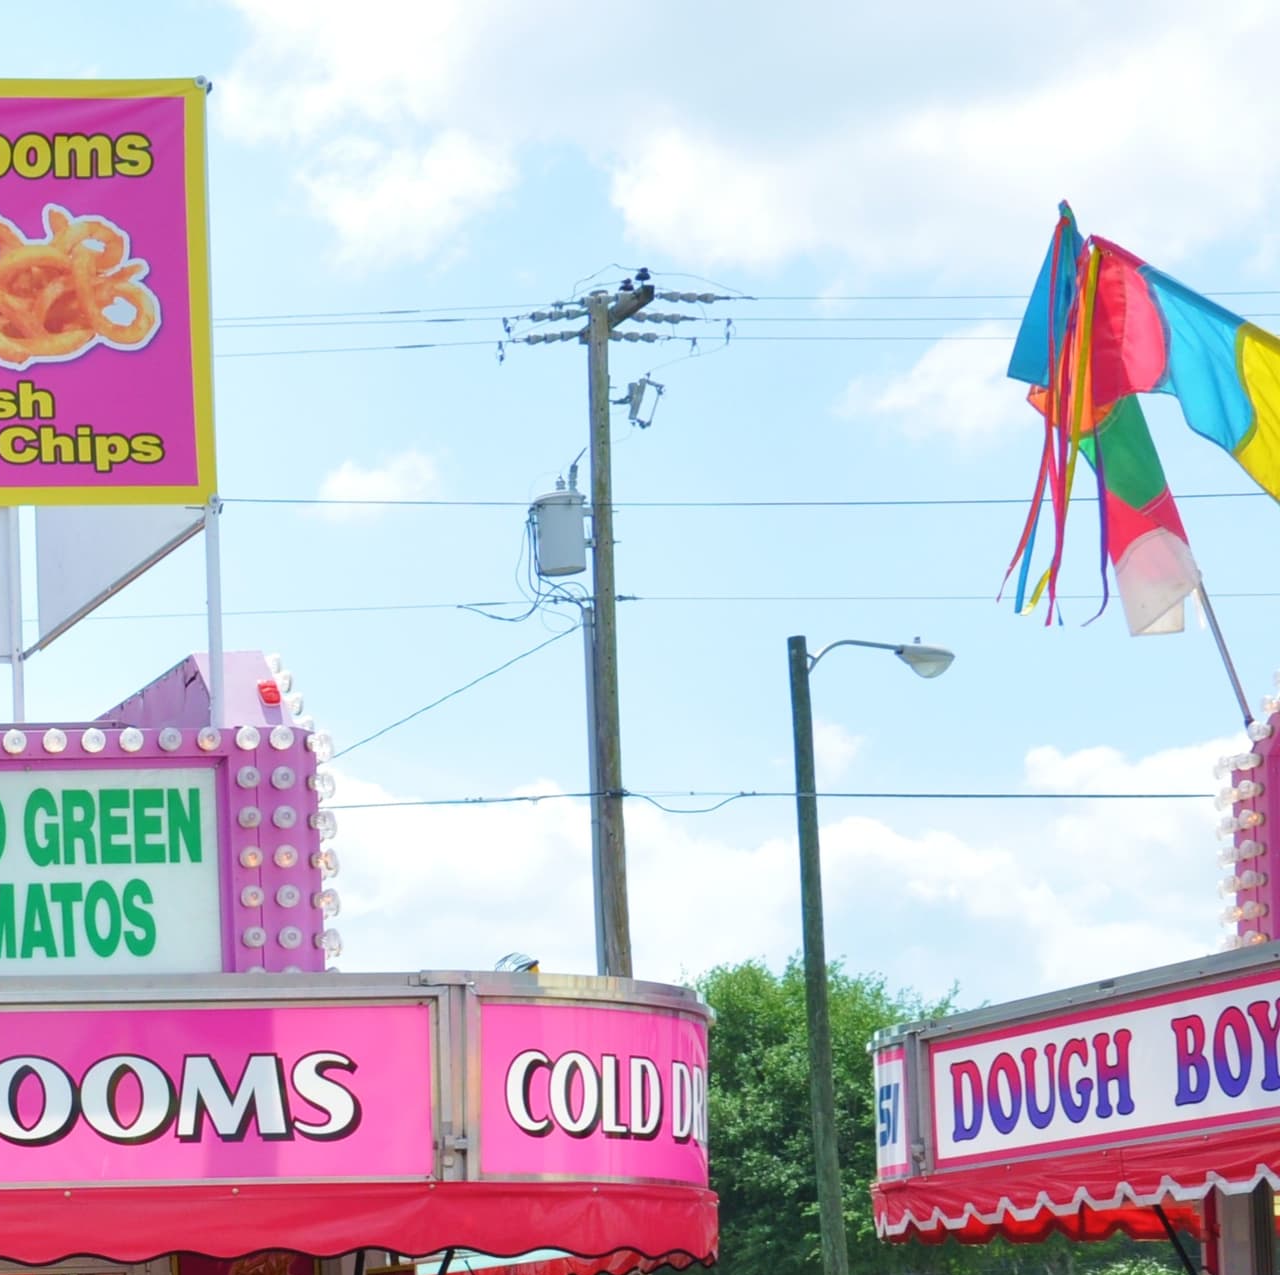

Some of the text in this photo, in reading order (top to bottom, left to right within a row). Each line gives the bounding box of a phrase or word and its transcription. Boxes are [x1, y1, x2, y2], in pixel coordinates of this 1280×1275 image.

[24, 786, 203, 866] GREEN
[505, 1049, 664, 1142] COLD
[950, 1027, 1134, 1143] DOUGH
